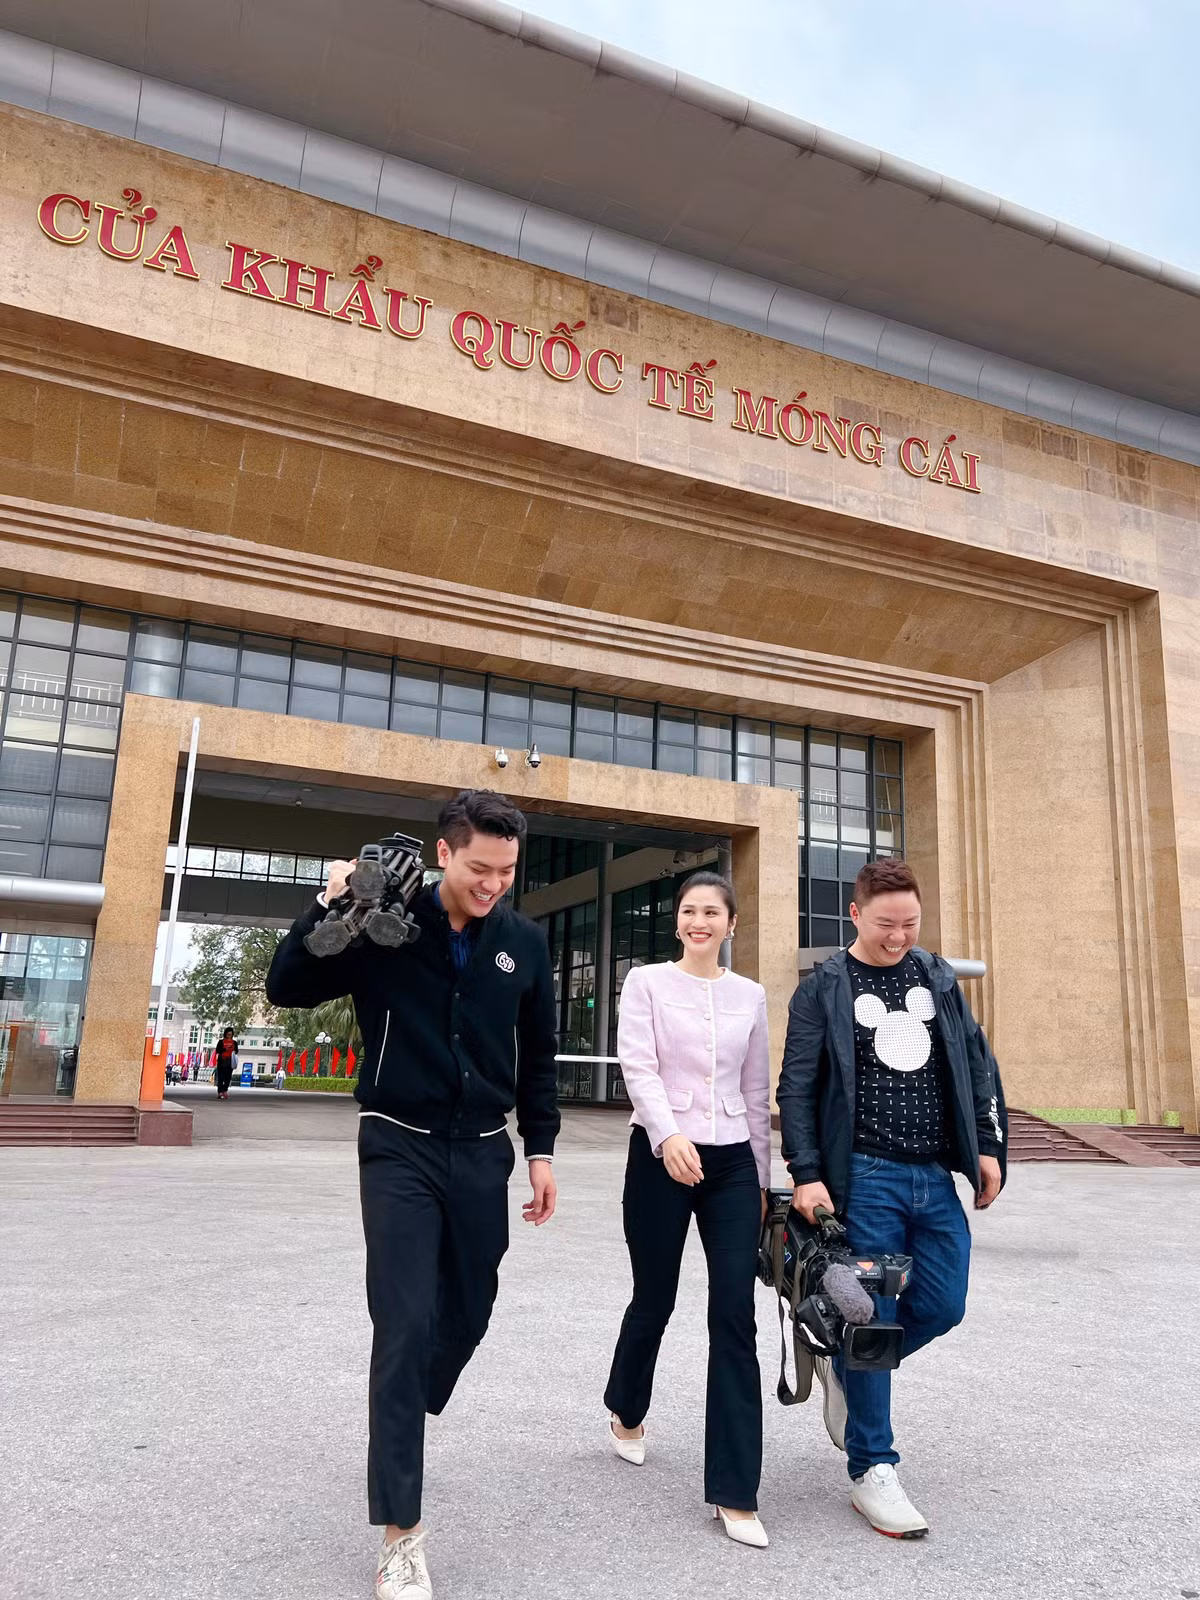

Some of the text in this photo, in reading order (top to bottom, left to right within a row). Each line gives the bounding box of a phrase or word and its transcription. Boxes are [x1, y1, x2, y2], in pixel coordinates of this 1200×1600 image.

[38, 188, 983, 494] CỬA KHẨU QUỐC TẾ MÓNG CÁI
